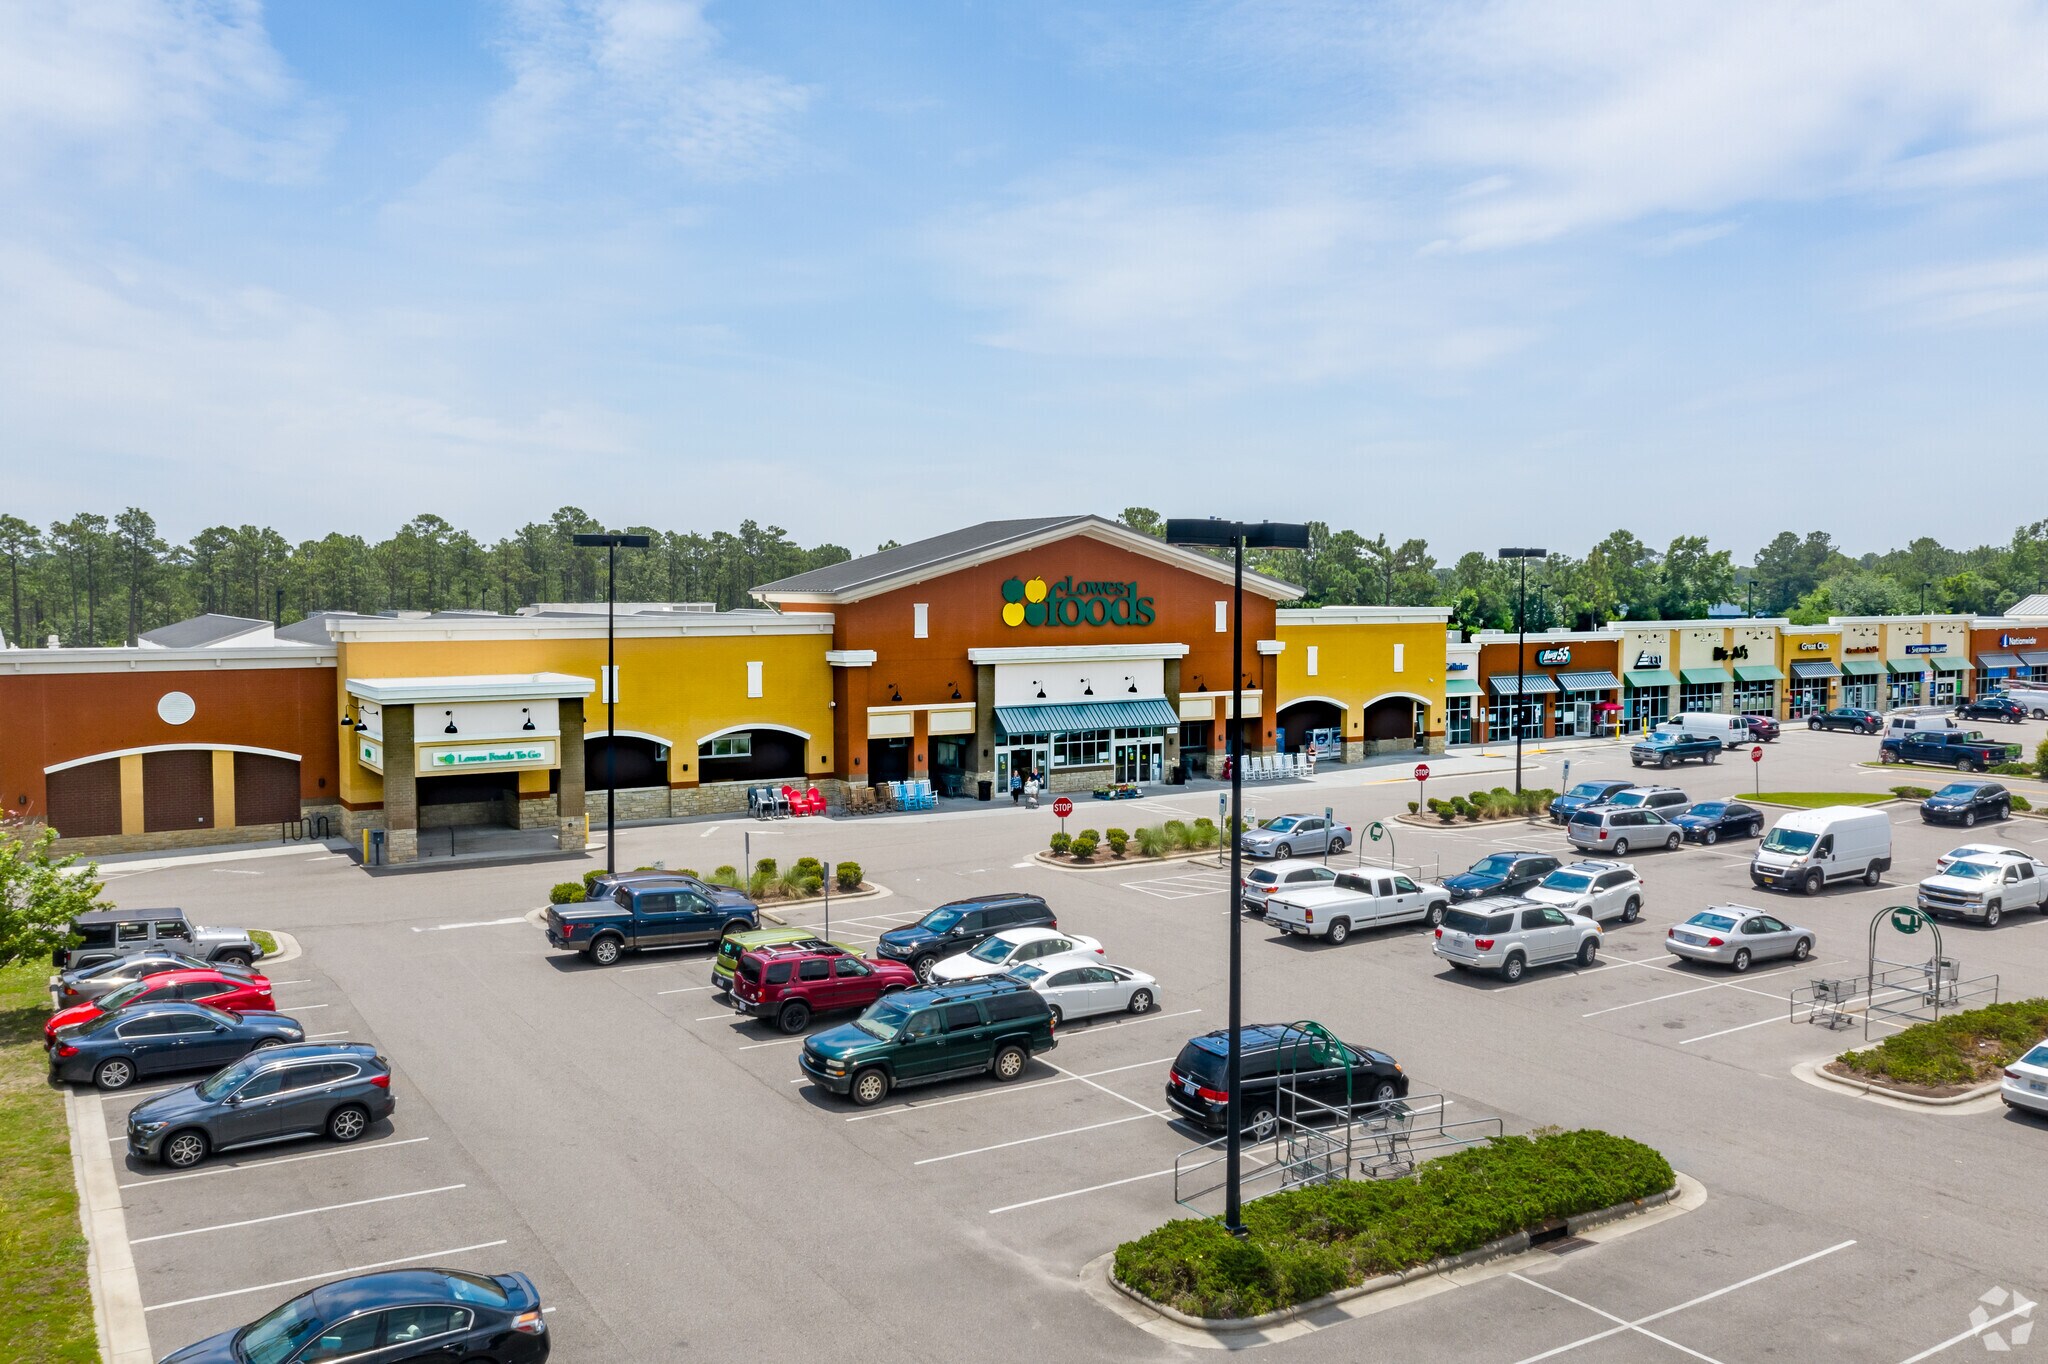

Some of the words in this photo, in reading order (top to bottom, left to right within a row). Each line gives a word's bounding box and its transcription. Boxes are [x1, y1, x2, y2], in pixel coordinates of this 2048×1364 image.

[1064, 575, 1125, 596] Lowes
[1044, 581, 1155, 626] foods
[2009, 637, 2037, 646] Nationwide
[1557, 646, 1570, 660] 55
[458, 754, 487, 763] Lowes
[489, 751, 514, 761] Foods
[515, 750, 526, 759] To
[527, 750, 541, 759] Go
[1415, 768, 1430, 776] STOP
[1054, 803, 1072, 812] STOP
